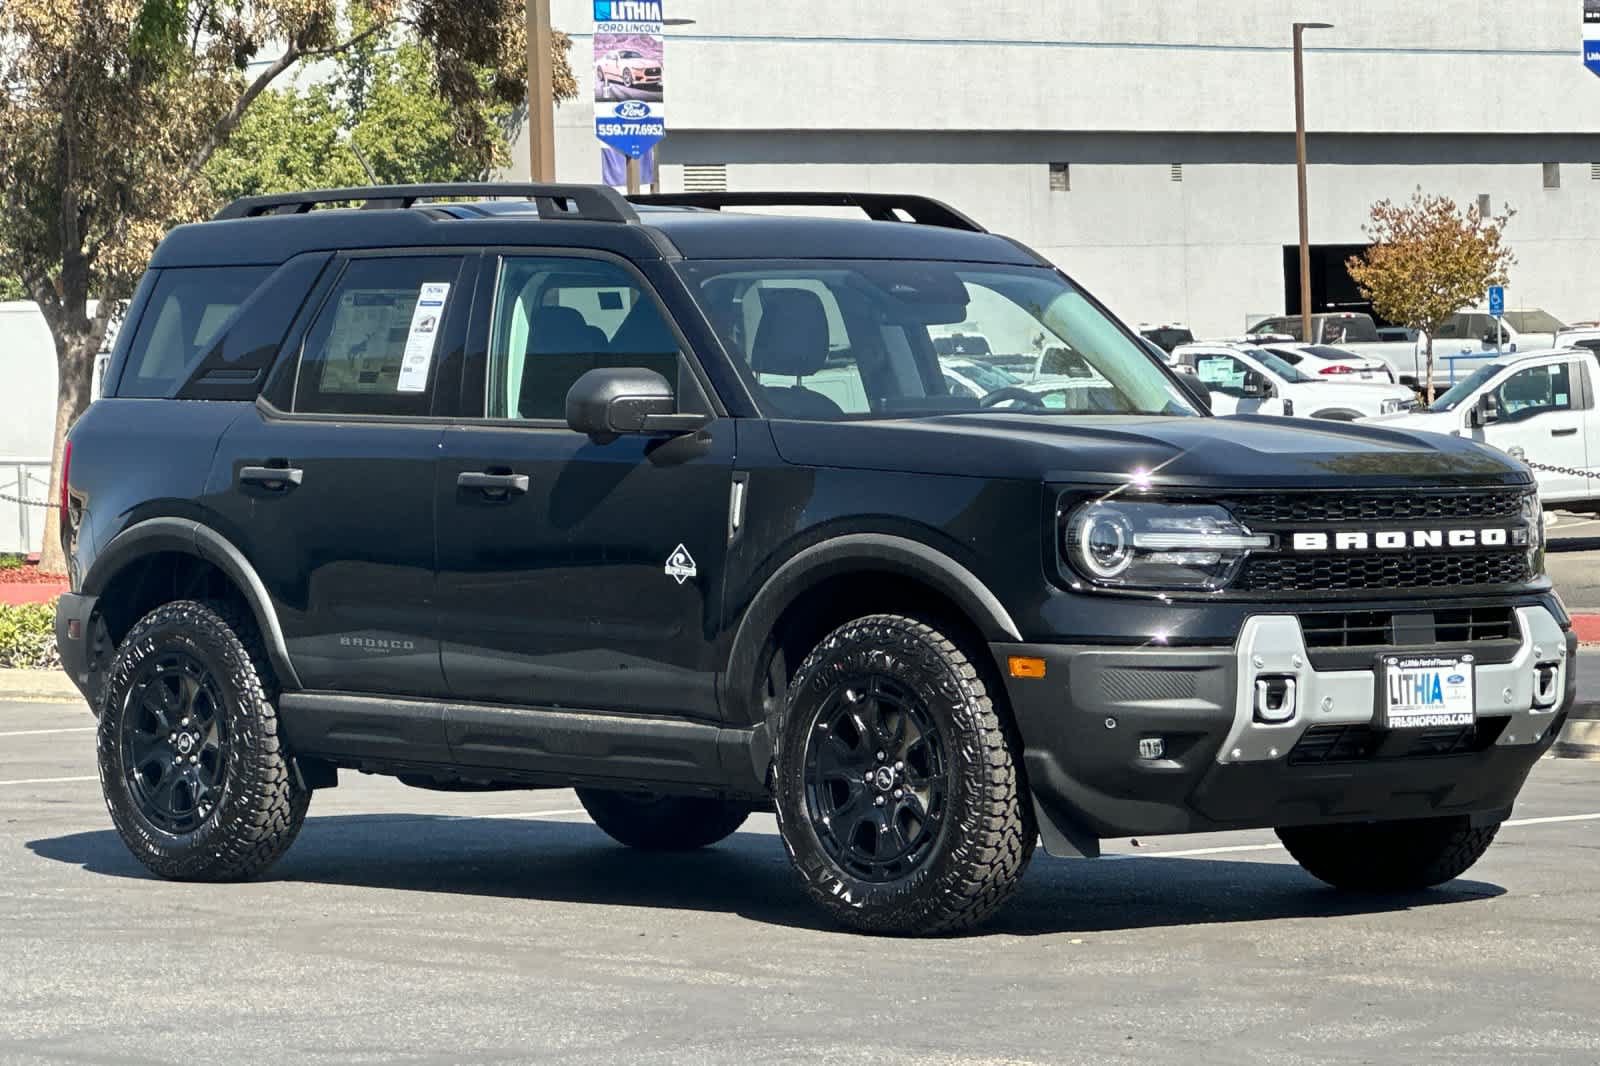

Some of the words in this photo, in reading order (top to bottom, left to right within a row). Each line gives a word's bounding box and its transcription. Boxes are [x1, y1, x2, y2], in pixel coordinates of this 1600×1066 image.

[611, 1, 661, 20] LITHIA
[598, 23, 624, 32] FORD
[626, 23, 661, 33] LINCOLN
[620, 103, 645, 117] Ford
[1293, 529, 1506, 550] BRONCO
[340, 637, 414, 648] BRONCO
[1389, 672, 1443, 705] LITHIA
[1389, 714, 1473, 728] FRESNOFORD.COM
